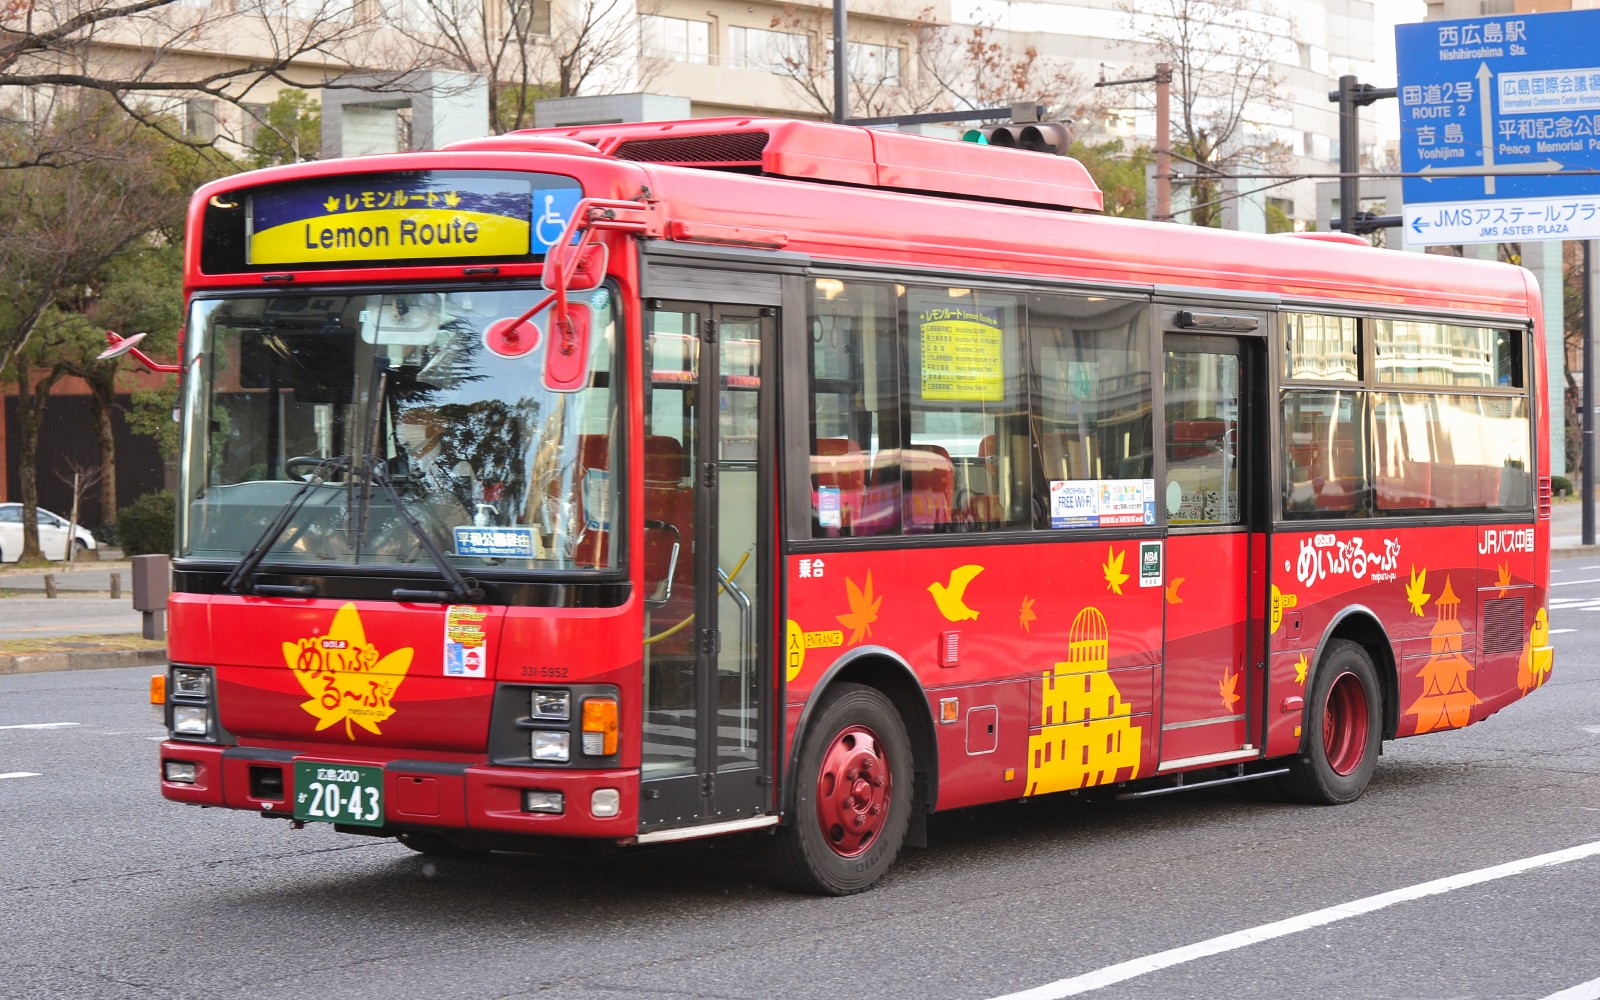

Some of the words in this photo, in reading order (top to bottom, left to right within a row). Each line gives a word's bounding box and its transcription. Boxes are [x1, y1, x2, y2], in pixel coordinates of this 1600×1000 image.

[1438, 20, 1527, 47] 西広島駅
[1439, 48, 1503, 61] Nishihiroshima
[1510, 45, 1527, 56] Sta.
[1403, 82, 1474, 106] 国道2号
[1412, 107, 1450, 119] ROUTE
[1458, 106, 1466, 117] 2
[1416, 123, 1464, 146] 吉島
[1418, 147, 1465, 161] Yoshijima
[1499, 143, 1531, 155] Peace
[1537, 140, 1583, 153] Memorial
[344, 189, 439, 210] レモンルート
[1434, 202, 1600, 228] JMSアステールプラ
[305, 221, 390, 250] Lemon
[400, 218, 479, 246] Route
[1479, 226, 1498, 237] JMS
[1503, 225, 1534, 236] ASTER
[1537, 223, 1569, 234] PLAZA
[1058, 496, 1074, 509] FREE
[1478, 528, 1535, 555] JRバス中国
[1144, 551, 1158, 562] NBA
[799, 558, 825, 578] 乗合
[1284, 595, 1295, 607] EXIT
[807, 632, 840, 647] ENTRANCE
[790, 633, 799, 667] 入口
[521, 666, 569, 678] 331-5952
[308, 782, 380, 821] 20-43
